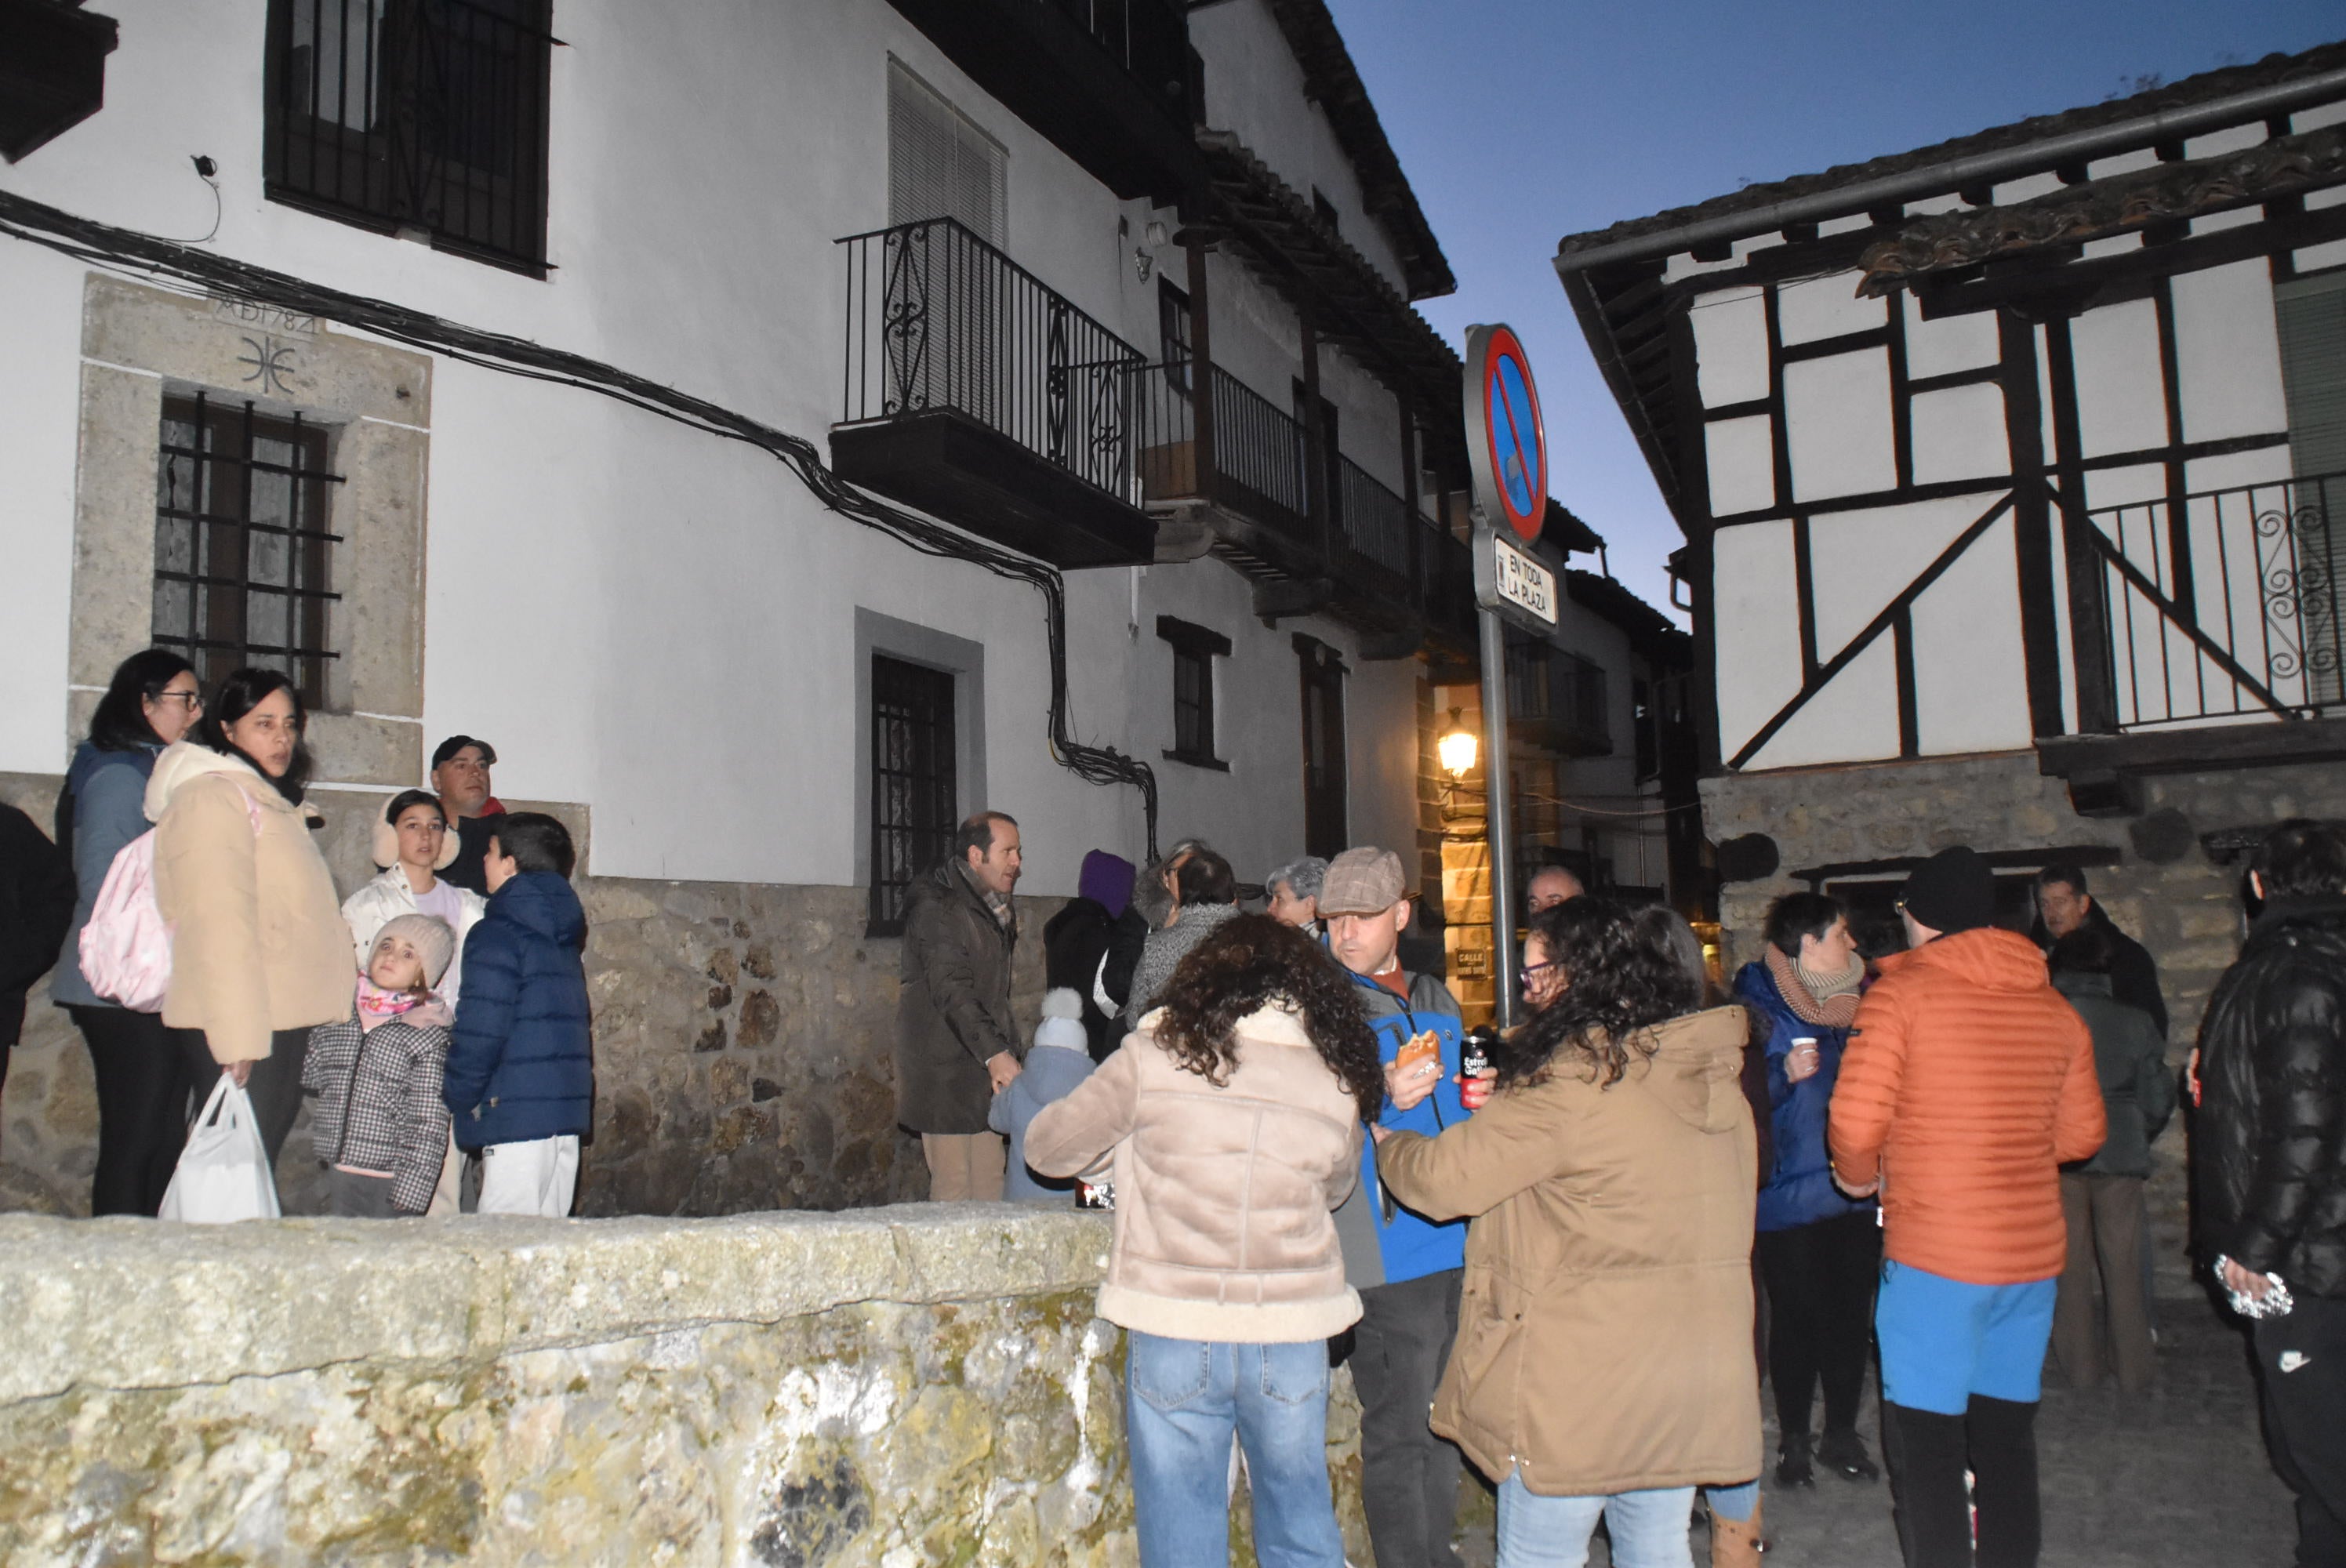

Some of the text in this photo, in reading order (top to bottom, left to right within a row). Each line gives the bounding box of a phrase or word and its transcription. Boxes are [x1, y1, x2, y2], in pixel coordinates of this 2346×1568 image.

[1510, 554, 1542, 590] EN TODA
[1509, 577, 1546, 613] LA PLAZA
[1458, 953, 1483, 962] CALLE
